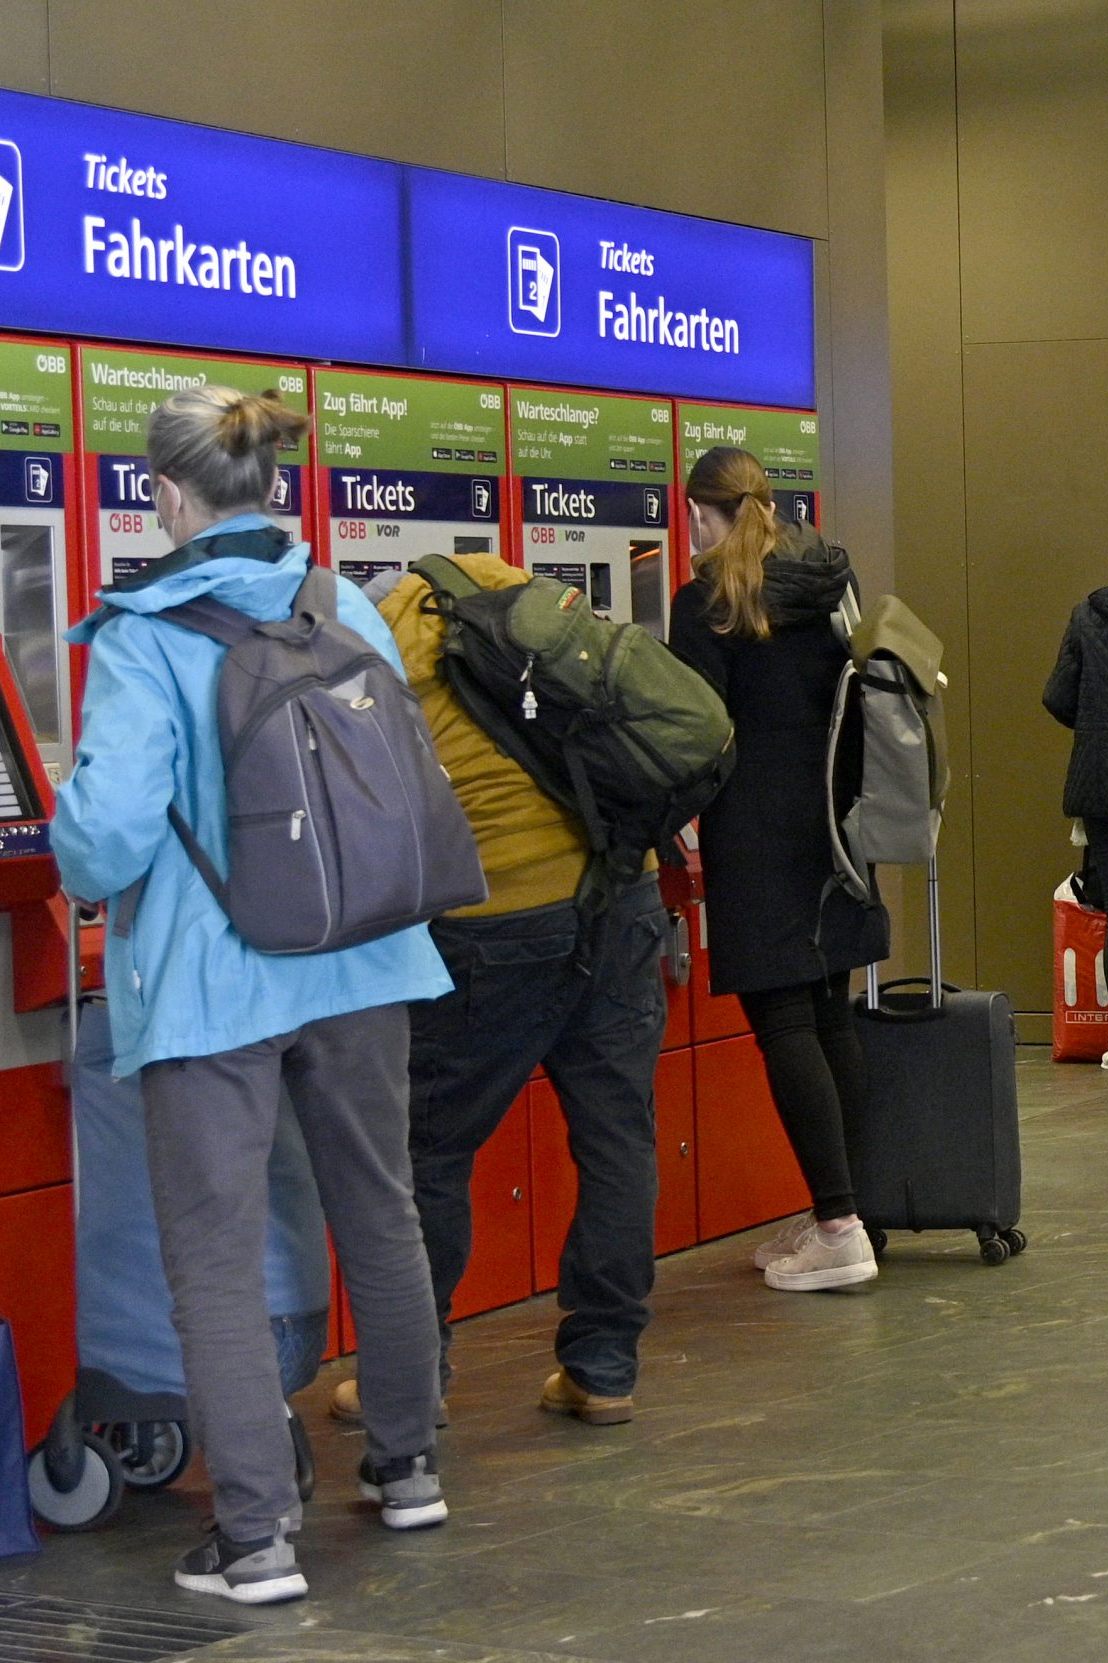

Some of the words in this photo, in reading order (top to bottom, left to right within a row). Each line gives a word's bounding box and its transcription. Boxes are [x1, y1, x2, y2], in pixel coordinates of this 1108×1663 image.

[83, 154, 167, 200] Tickets
[83, 215, 297, 299] Fahrkarten
[599, 241, 654, 276] Tickets
[598, 291, 739, 354] Fahrkarten
[37, 354, 66, 374] ÖBB
[91, 363, 206, 391] Warteschlange?
[279, 376, 304, 393] ÖBB
[93, 397, 117, 412] Schau
[120, 399, 133, 412] auf
[135, 403, 147, 414] die
[323, 392, 346, 416] Zug
[350, 395, 377, 413] fährt
[381, 398, 408, 420] App!
[480, 394, 501, 409] ÖBB
[517, 401, 599, 428] Warteschlange?
[651, 409, 669, 423] ÖBB
[93, 417, 107, 430] auf
[110, 419, 121, 432] die
[124, 420, 141, 433] Uhr.
[325, 423, 341, 436] Die
[343, 425, 379, 440] Sparschiene
[685, 422, 701, 442] Zug
[704, 423, 724, 439] fährt
[727, 425, 746, 446] App!
[800, 421, 816, 434] ÖBB
[518, 429, 536, 443] Schau
[537, 430, 547, 443] auf
[549, 431, 558, 443] die
[559, 433, 573, 447] App
[574, 434, 587, 446] statt
[325, 440, 342, 455] fährt
[518, 447, 529, 459] auf
[530, 447, 539, 460] die
[686, 448, 694, 459] Die
[342, 475, 415, 512] Tickets
[532, 485, 596, 519] Tickets
[110, 513, 143, 533] ÖBB
[339, 521, 366, 539] ÖBB
[377, 524, 400, 538] VOR
[531, 528, 555, 544] ÖBB
[565, 530, 585, 542] VOR
